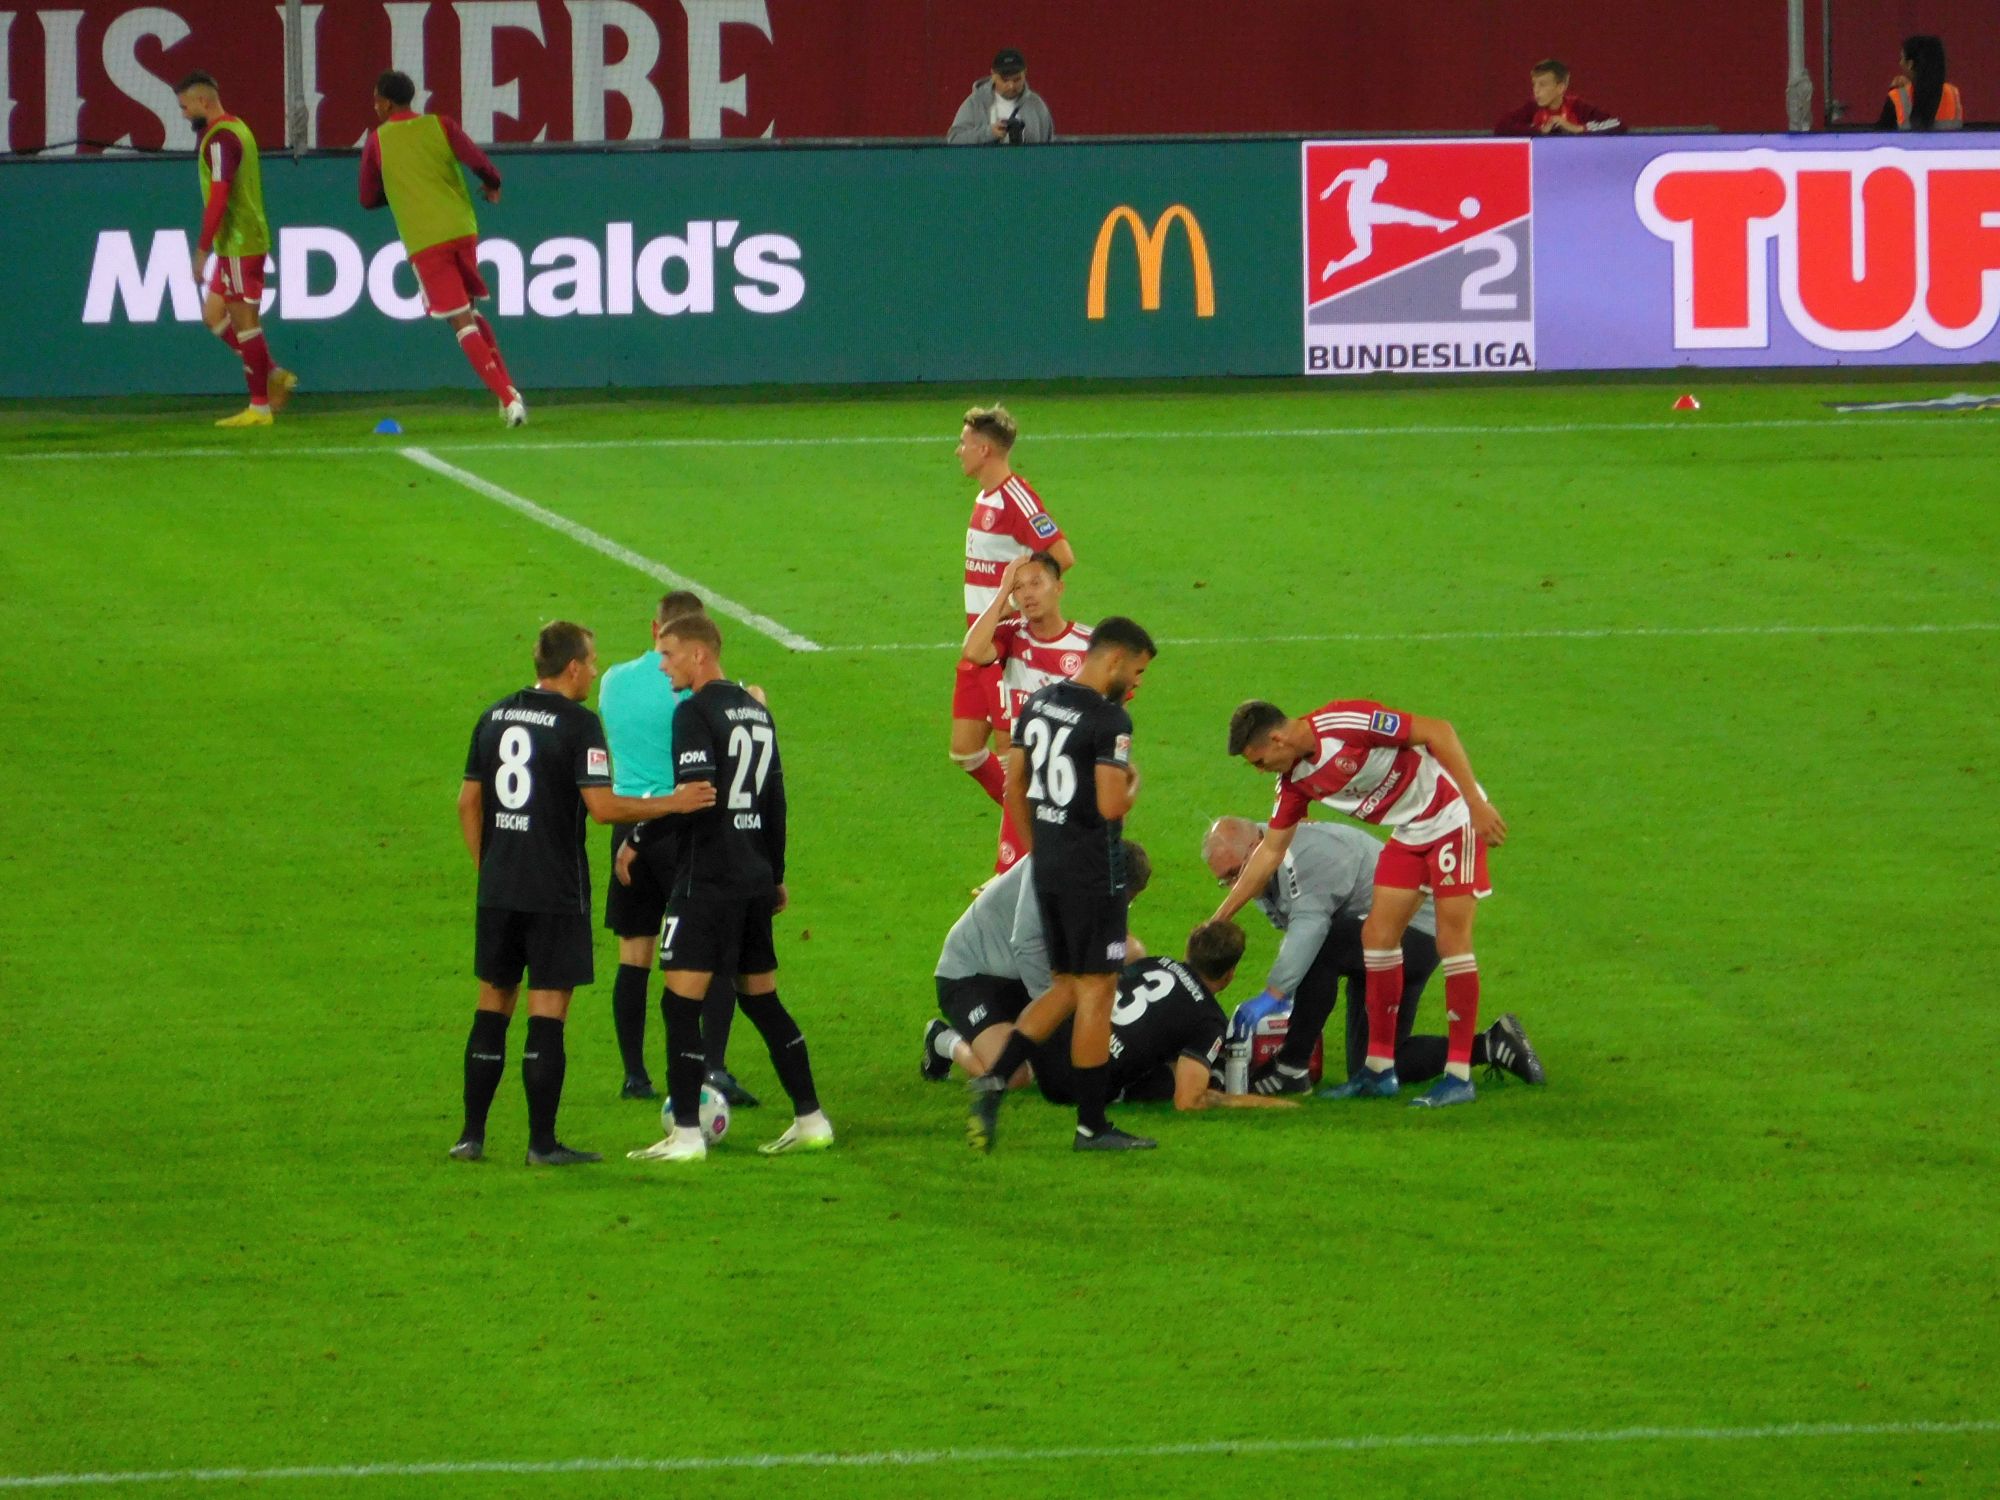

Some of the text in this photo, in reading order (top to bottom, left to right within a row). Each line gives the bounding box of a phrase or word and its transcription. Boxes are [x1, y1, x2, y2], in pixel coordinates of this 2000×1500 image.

[275, 0, 774, 149] LIEBE
[82, 220, 806, 323] MDonald's
[1461, 232, 1518, 310] 2
[1308, 342, 1532, 370] BUNDESLIGA
[495, 725, 532, 809] 8
[679, 750, 707, 766] JOPA
[727, 725, 773, 809] 27
[1023, 717, 1078, 807] 26
[495, 812, 531, 832] TESCHE
[1438, 841, 1457, 873] 6
[1110, 968, 1176, 1026] 3
